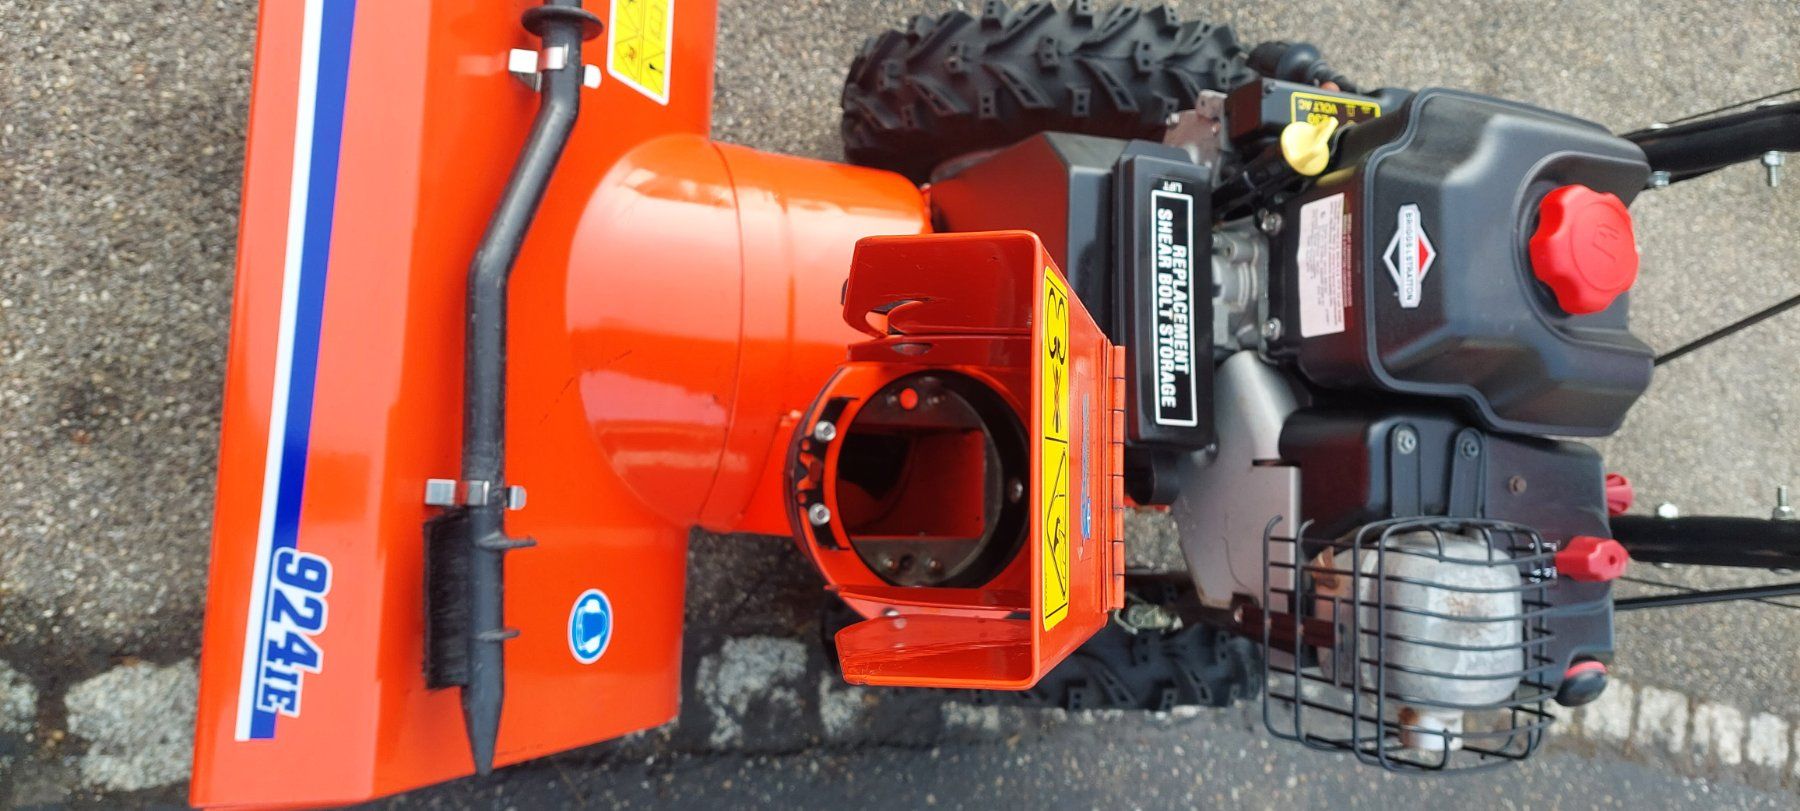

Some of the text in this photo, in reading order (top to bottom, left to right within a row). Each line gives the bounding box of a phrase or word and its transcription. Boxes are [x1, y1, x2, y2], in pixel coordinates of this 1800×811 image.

[1313, 101, 1338, 115] VOLT
[1163, 180, 1183, 193] LIFT
[1405, 212, 1413, 248] BRIGGS
[1405, 255, 1414, 301] STRATTON
[1157, 207, 1177, 409] SHEAR BOLT STORAGE
[1173, 244, 1189, 375] REPLACEMENT
